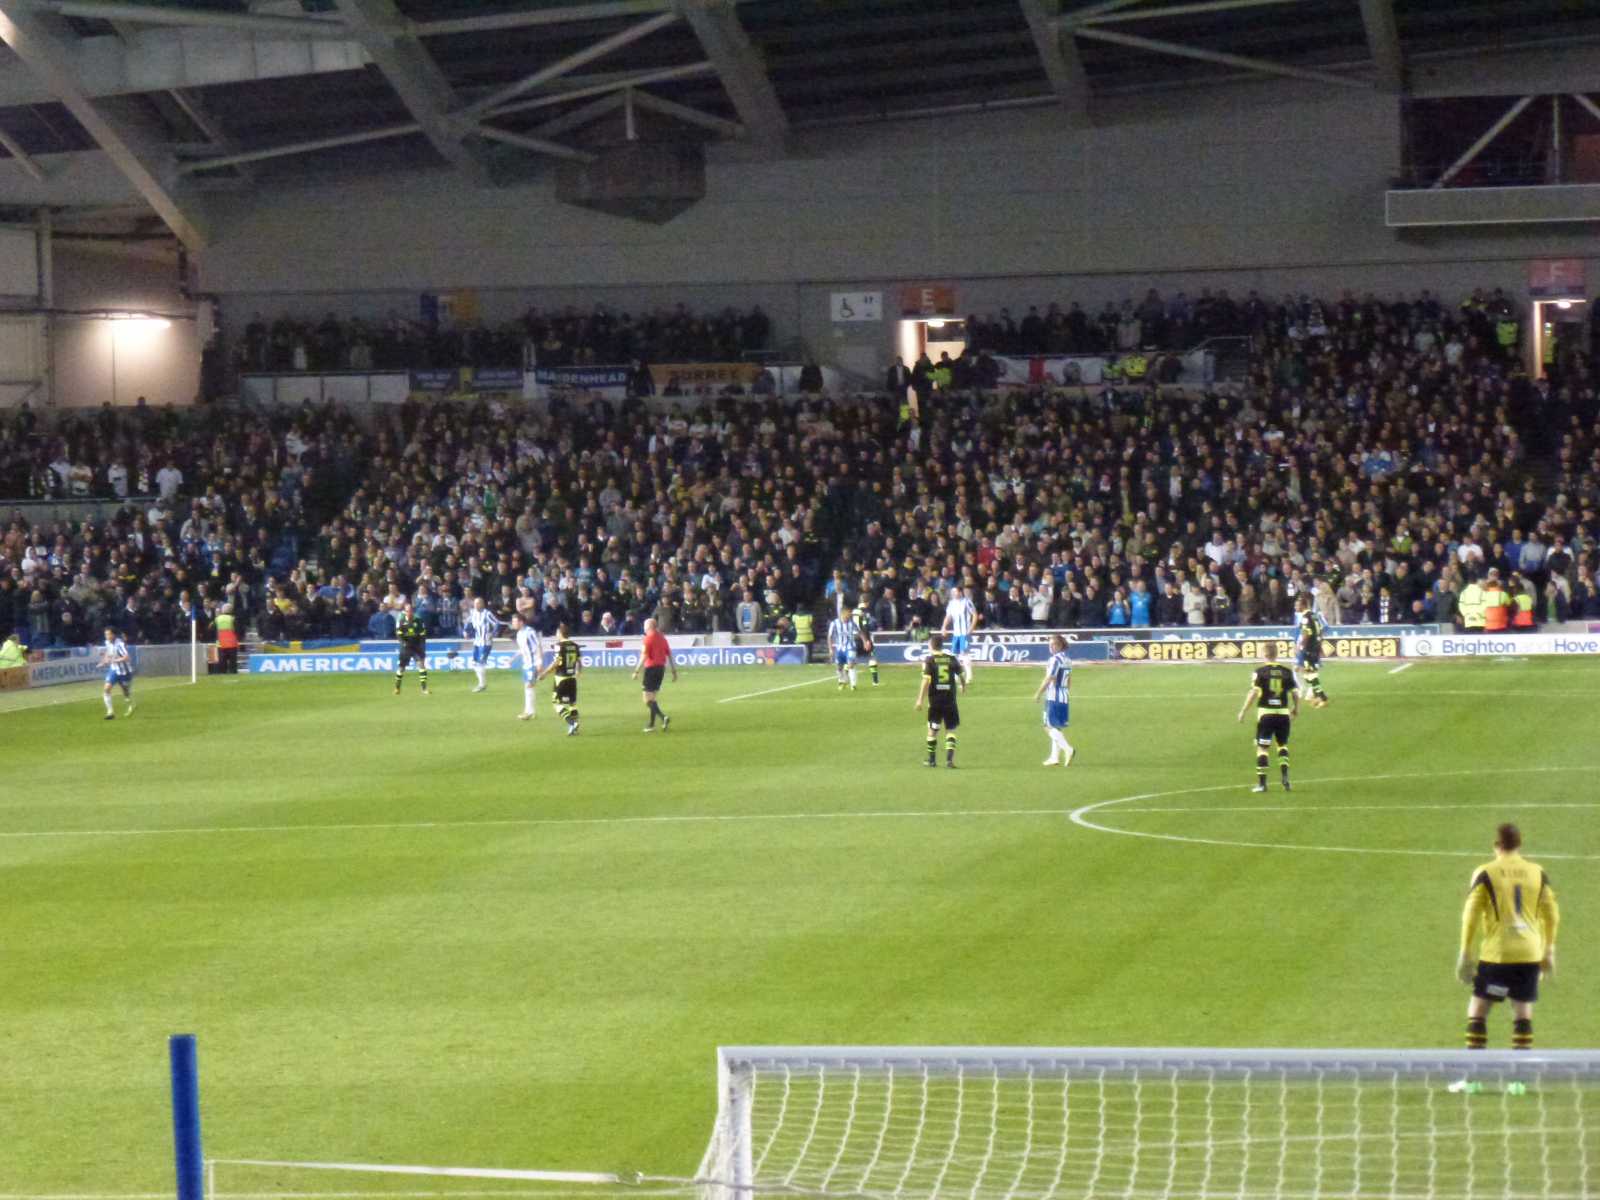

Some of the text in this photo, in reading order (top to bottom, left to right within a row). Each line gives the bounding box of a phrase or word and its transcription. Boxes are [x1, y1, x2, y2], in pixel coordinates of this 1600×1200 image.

[921, 288, 934, 306] E
[1148, 638, 1397, 660] errea erea errea
[1442, 639, 1516, 656] Brighton
[1554, 638, 1598, 652] Hove
[260, 657, 392, 672] AMERICAN
[581, 649, 638, 667] erline
[938, 665, 949, 683] 5
[1514, 884, 1522, 912] 1
